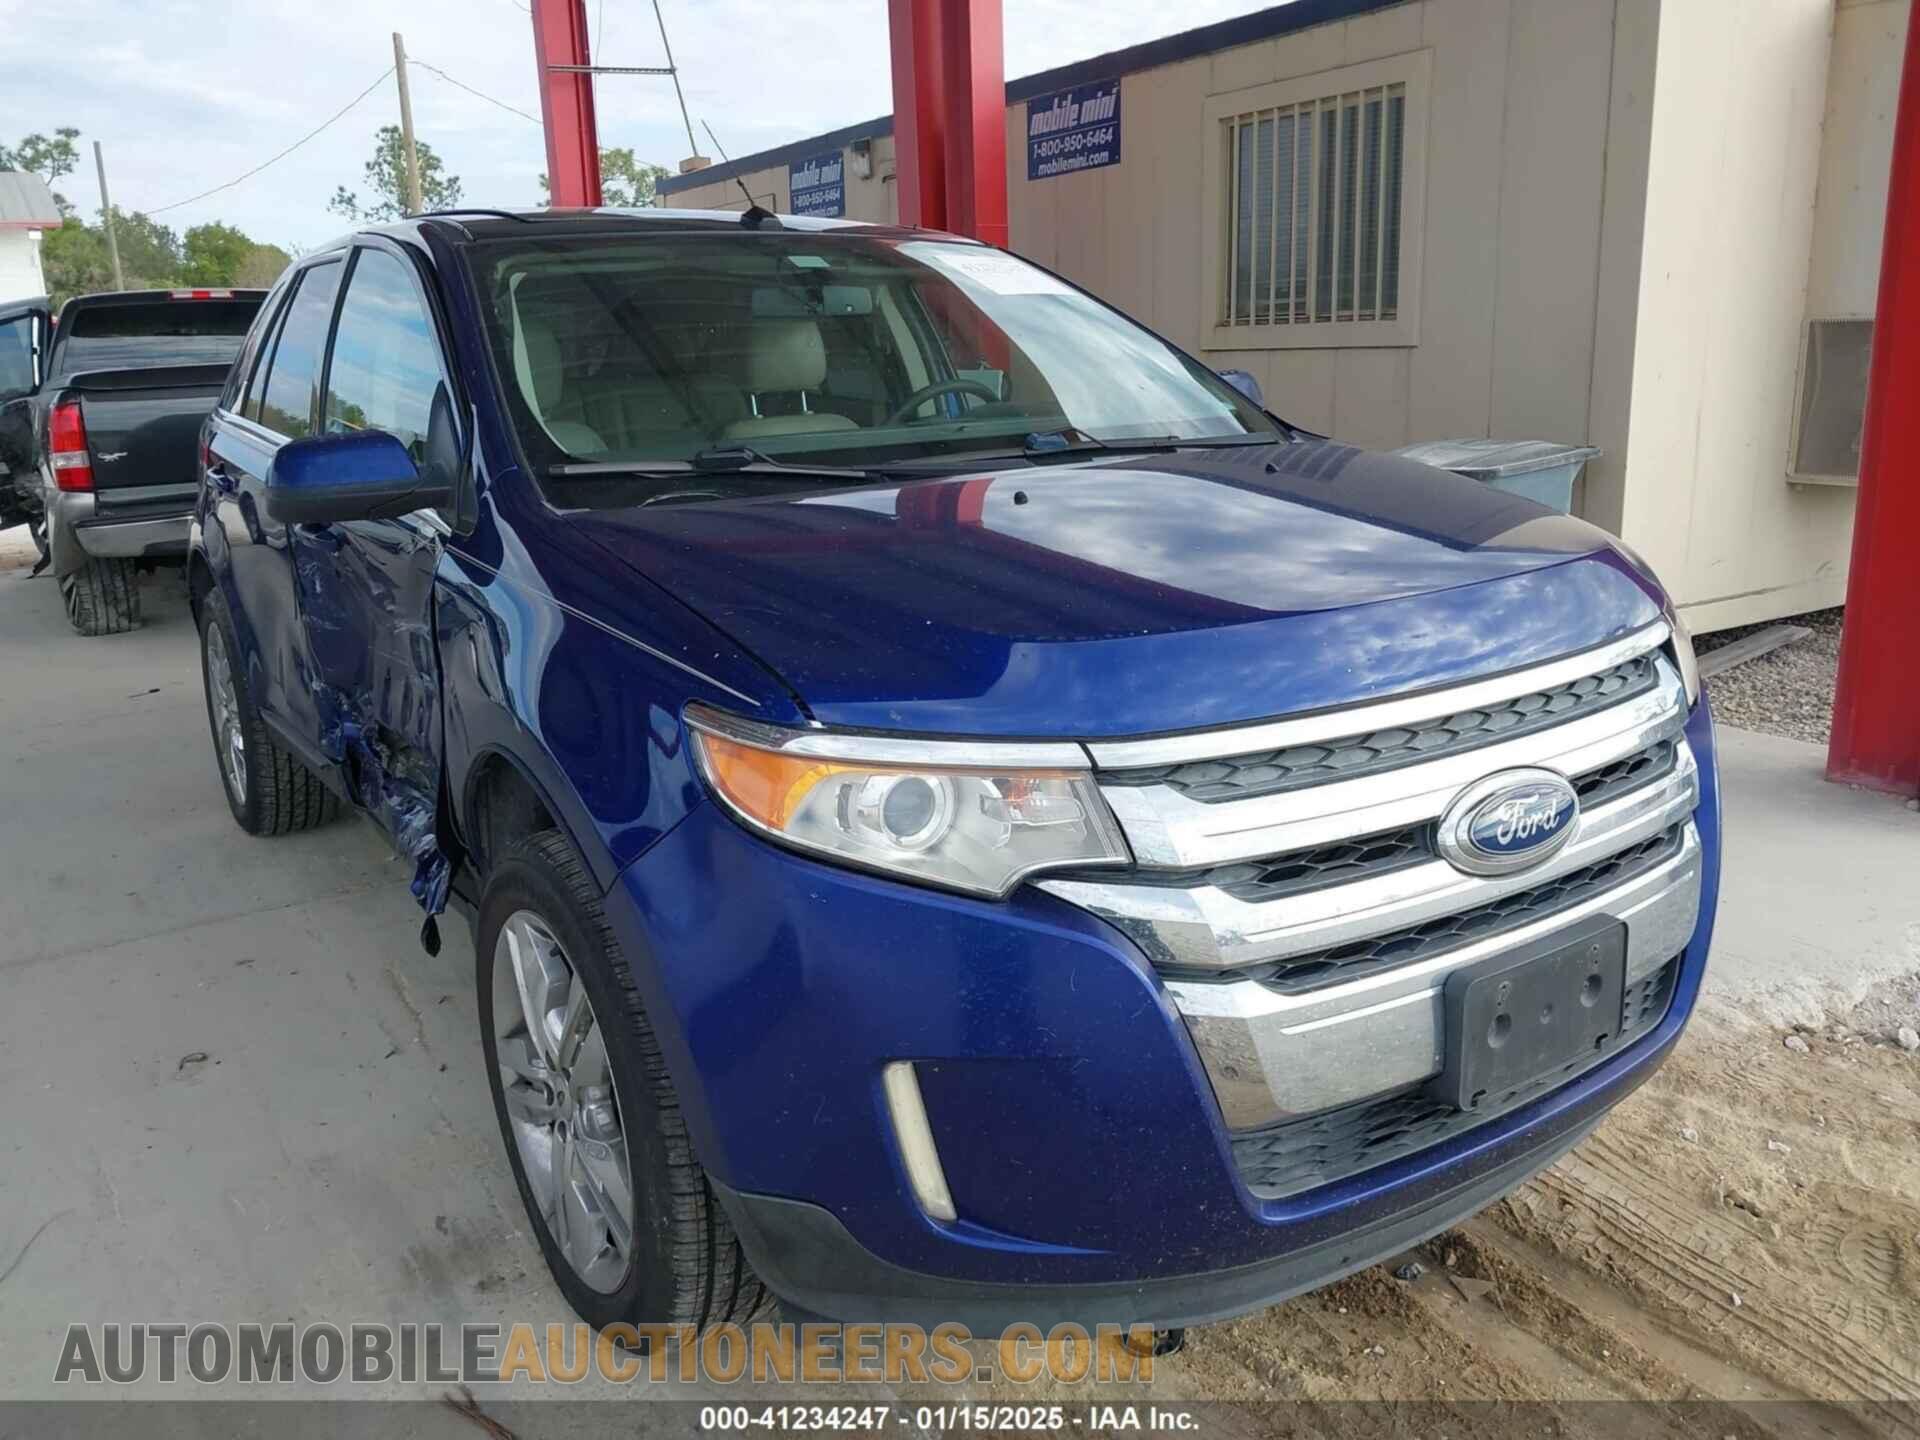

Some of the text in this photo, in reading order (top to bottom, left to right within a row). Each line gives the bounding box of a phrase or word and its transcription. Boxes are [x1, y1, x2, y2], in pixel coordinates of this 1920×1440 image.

[1030, 87, 1119, 136] mobile mini
[1033, 127, 1113, 159] 1-800-950-6464
[791, 158, 842, 190] mobile mini
[1037, 151, 1110, 176] mobilemini.com
[1497, 794, 1560, 845] Ford
